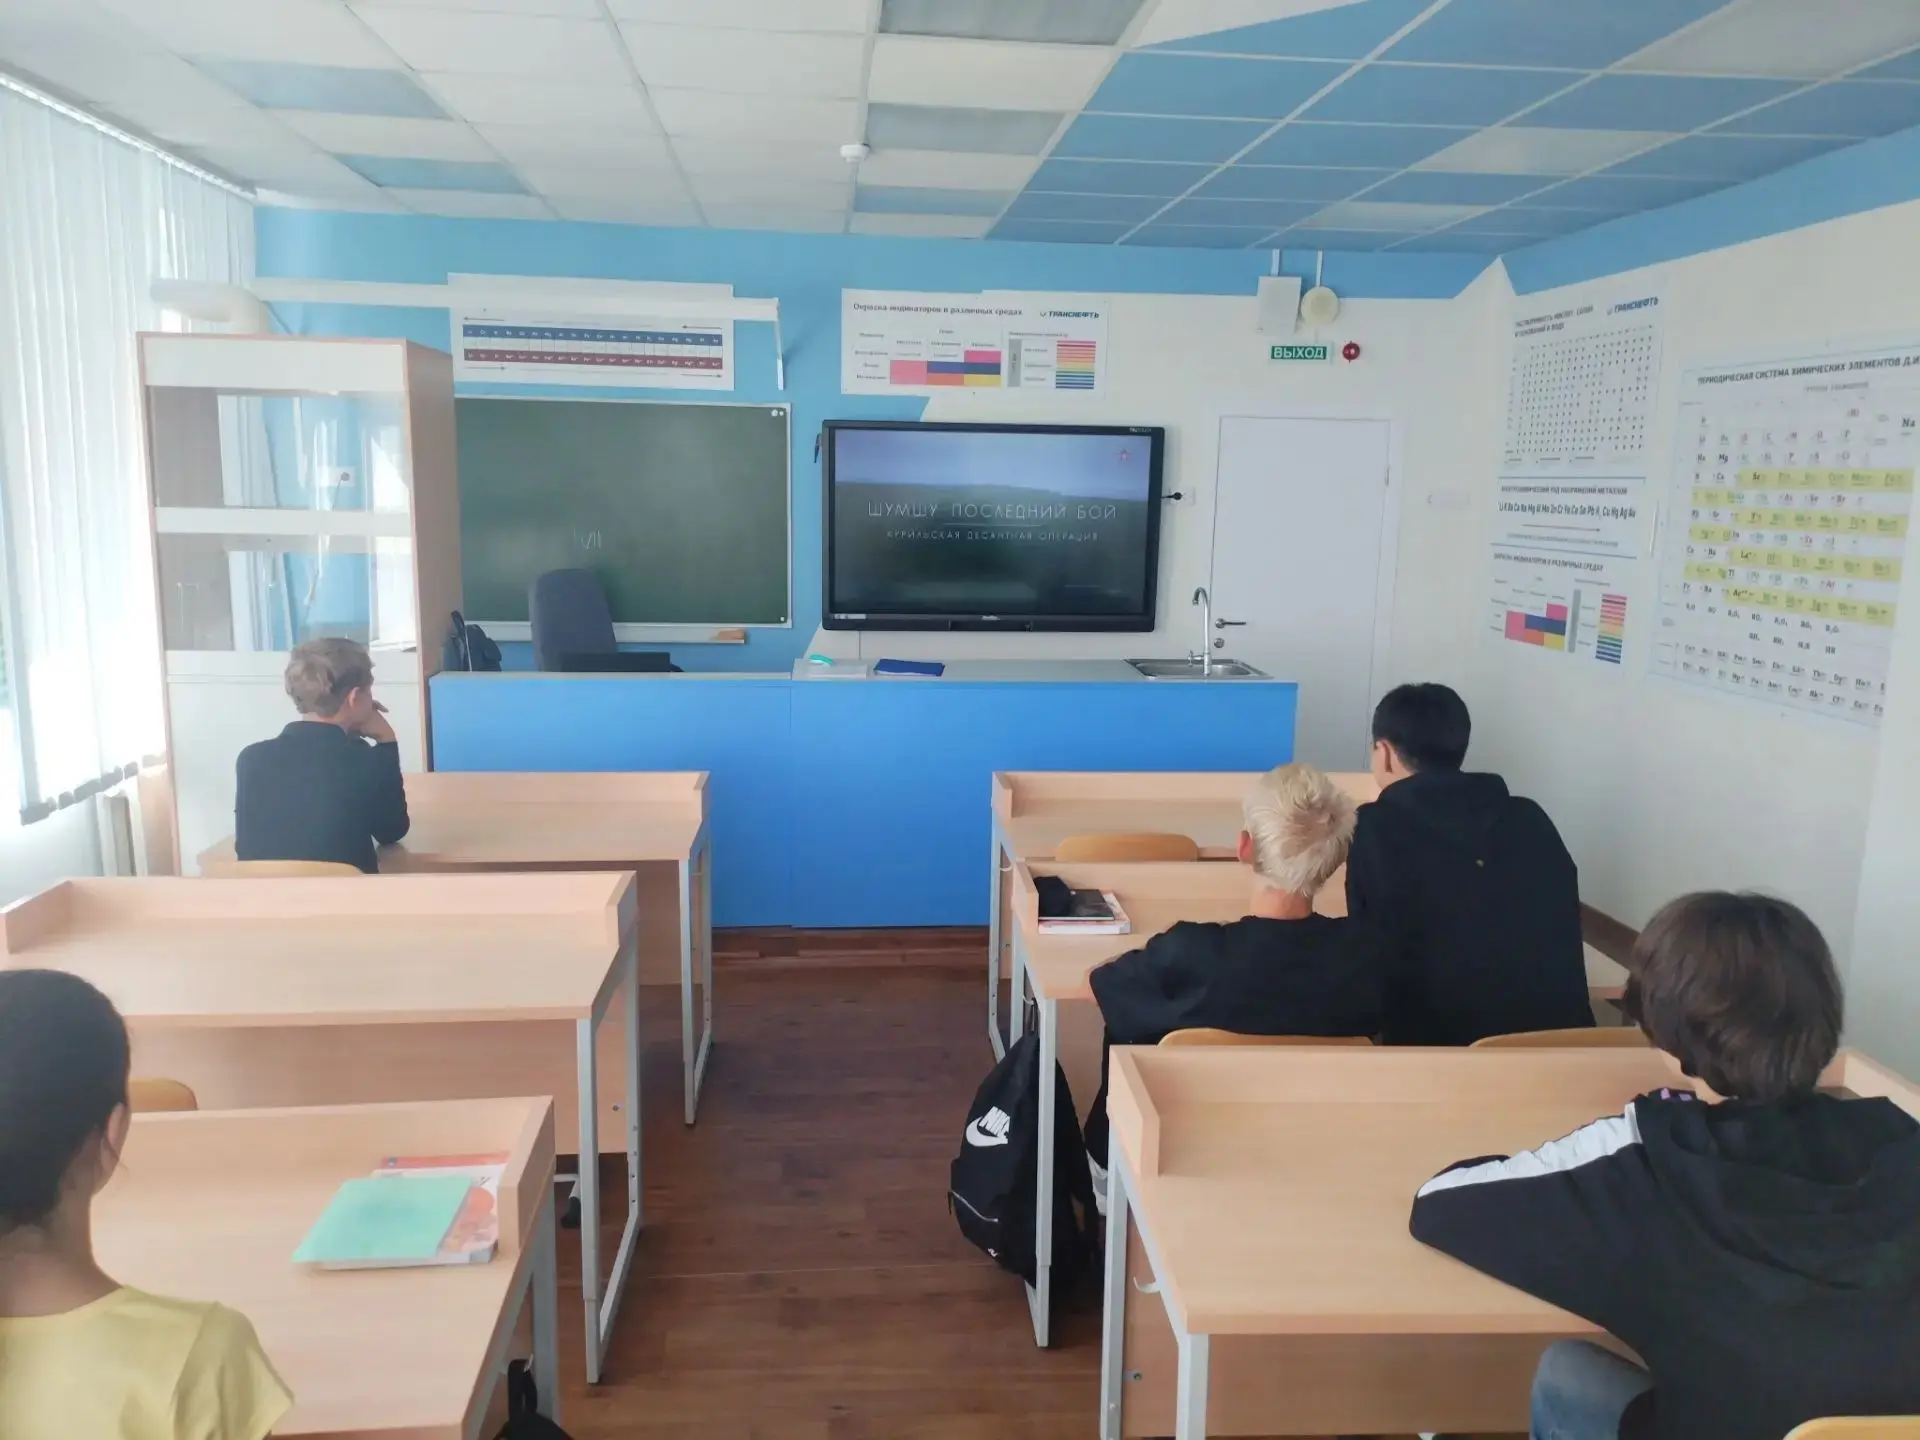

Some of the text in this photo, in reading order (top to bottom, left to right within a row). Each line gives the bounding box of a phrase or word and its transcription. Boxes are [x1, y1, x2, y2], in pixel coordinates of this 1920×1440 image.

[1048, 311, 1099, 319] ТРАНСНЕФТЬ
[1274, 347, 1324, 359] ВЫХОД
[1698, 372, 1753, 385] ПЕРИОДИЧЕСКАЯ
[1755, 368, 1789, 379] СИСТЕМА
[1791, 363, 1846, 375] ХИМИЧЕСКИХ
[1848, 356, 1901, 371] ЭЛЕМЕНТОВ
[868, 501, 1117, 521] ШУМШУ ПОСЛЕДНИЙ БОЙ
[886, 530, 1099, 542] КУРИЛЬСКАЯ ДЕСАНТНАЯ ОПЕРАЦИЯ
